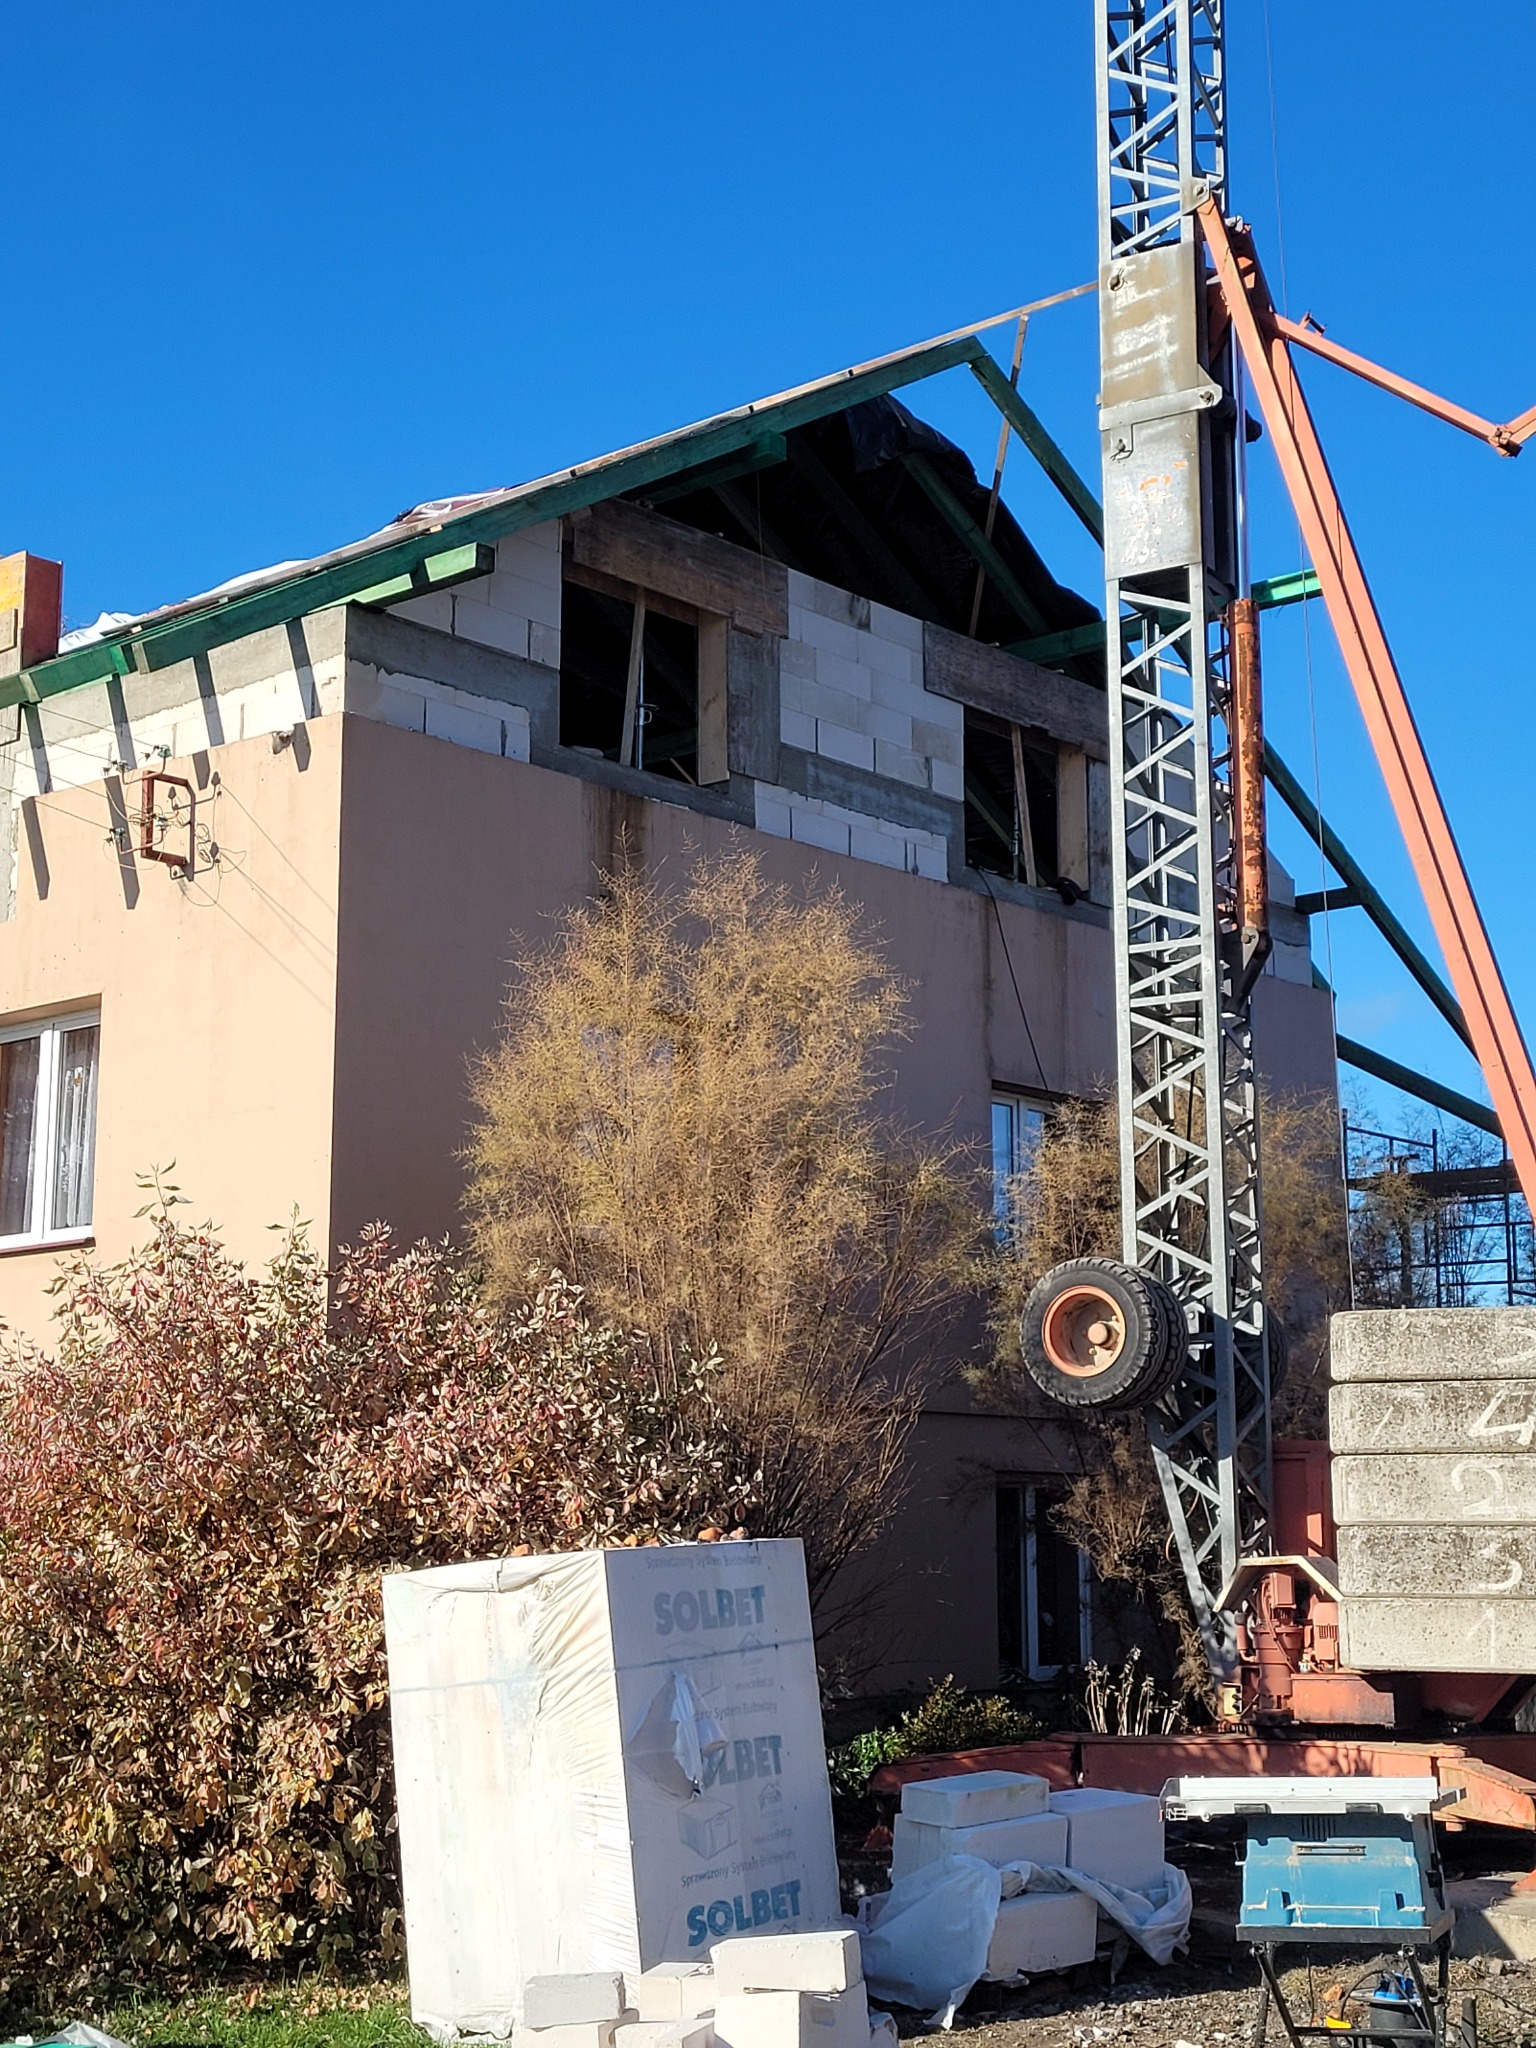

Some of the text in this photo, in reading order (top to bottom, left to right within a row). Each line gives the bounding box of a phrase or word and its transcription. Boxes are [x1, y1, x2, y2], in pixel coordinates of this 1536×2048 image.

[1467, 1381, 1535, 1446] 4
[1451, 1460, 1517, 1515] 2
[653, 1585, 765, 1636] SOLBET
[1465, 1607, 1496, 1664] 1
[681, 1865, 729, 1888] Sprawdzony
[687, 1879, 801, 1947] SOLBET
